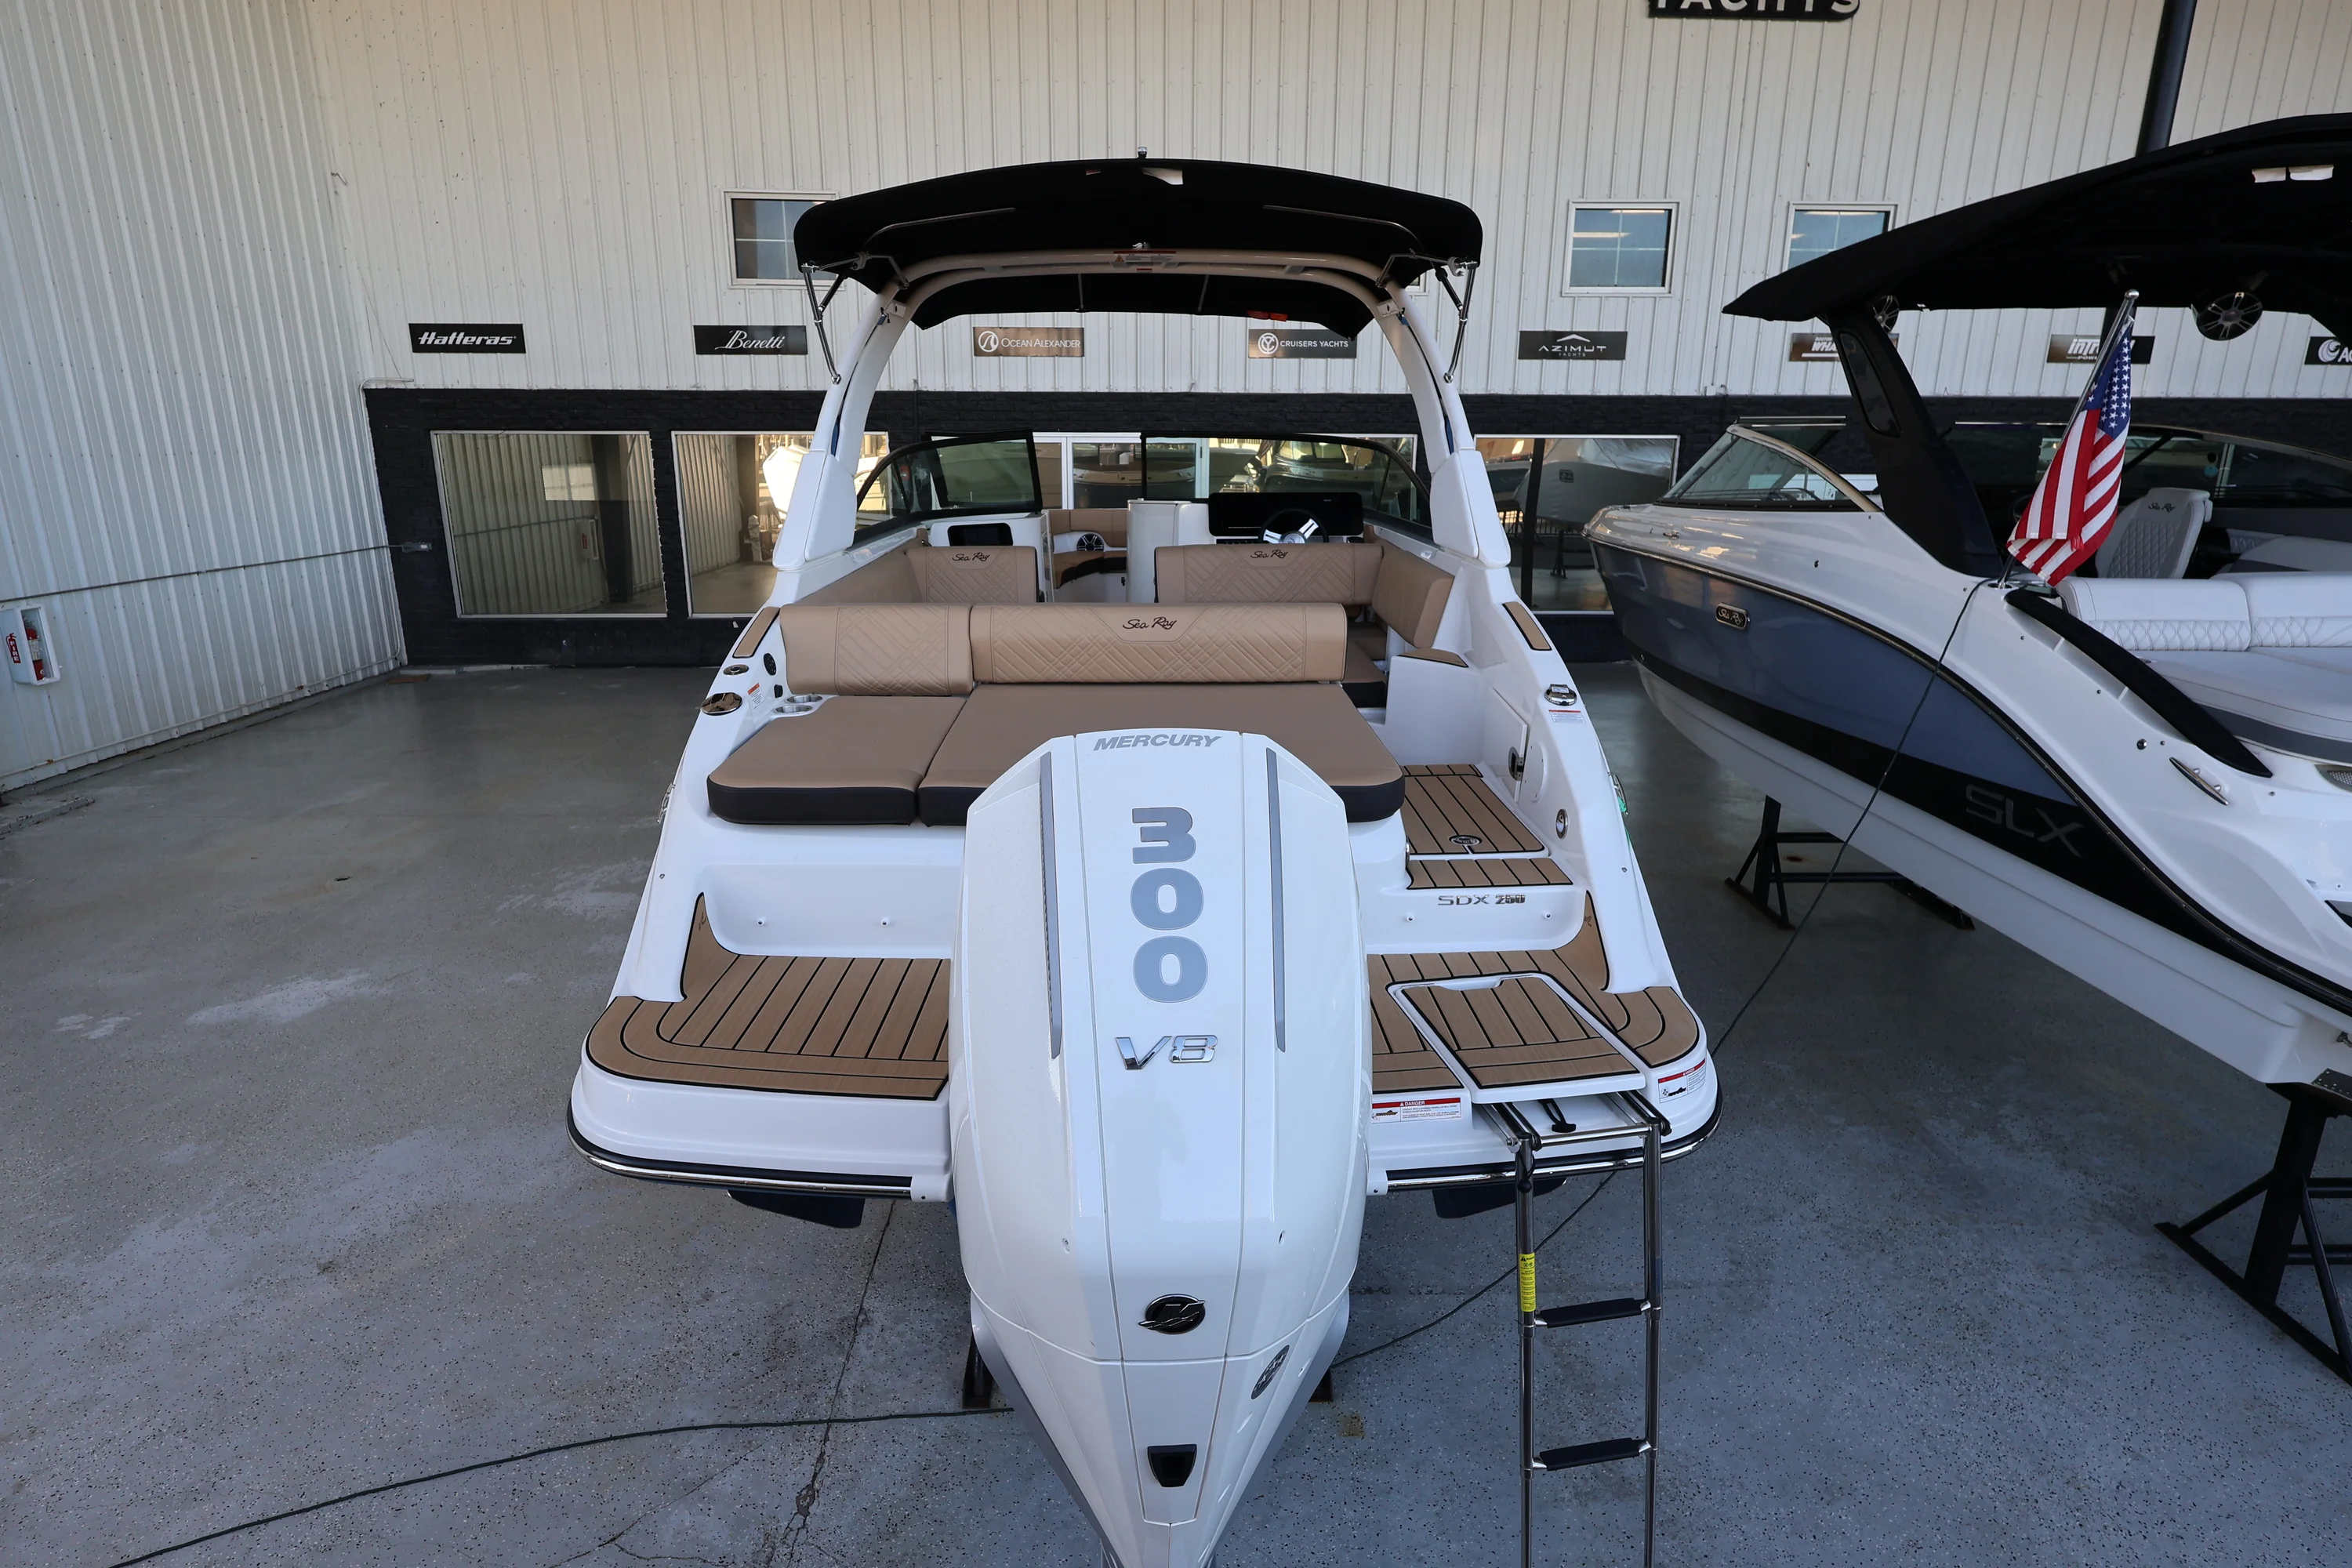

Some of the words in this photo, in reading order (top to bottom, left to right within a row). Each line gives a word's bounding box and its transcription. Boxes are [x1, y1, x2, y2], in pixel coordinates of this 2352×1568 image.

[714, 329, 786, 350] Benetti
[1001, 337, 1032, 347] OCEAN
[1033, 338, 1080, 348] ALEXANDER
[1811, 341, 1838, 352] WHA
[972, 552, 990, 561] Ray
[1271, 550, 1288, 559] Ray
[1123, 619, 1149, 629] Sea
[1151, 616, 1177, 630] Ray
[9, 641, 20, 662] FIRE
[1093, 734, 1221, 751] MERCURY
[1965, 784, 2085, 859] SLX
[1130, 807, 1208, 1004] 300
[1438, 895, 1490, 906] SDX
[1115, 1034, 1218, 1070] V8
